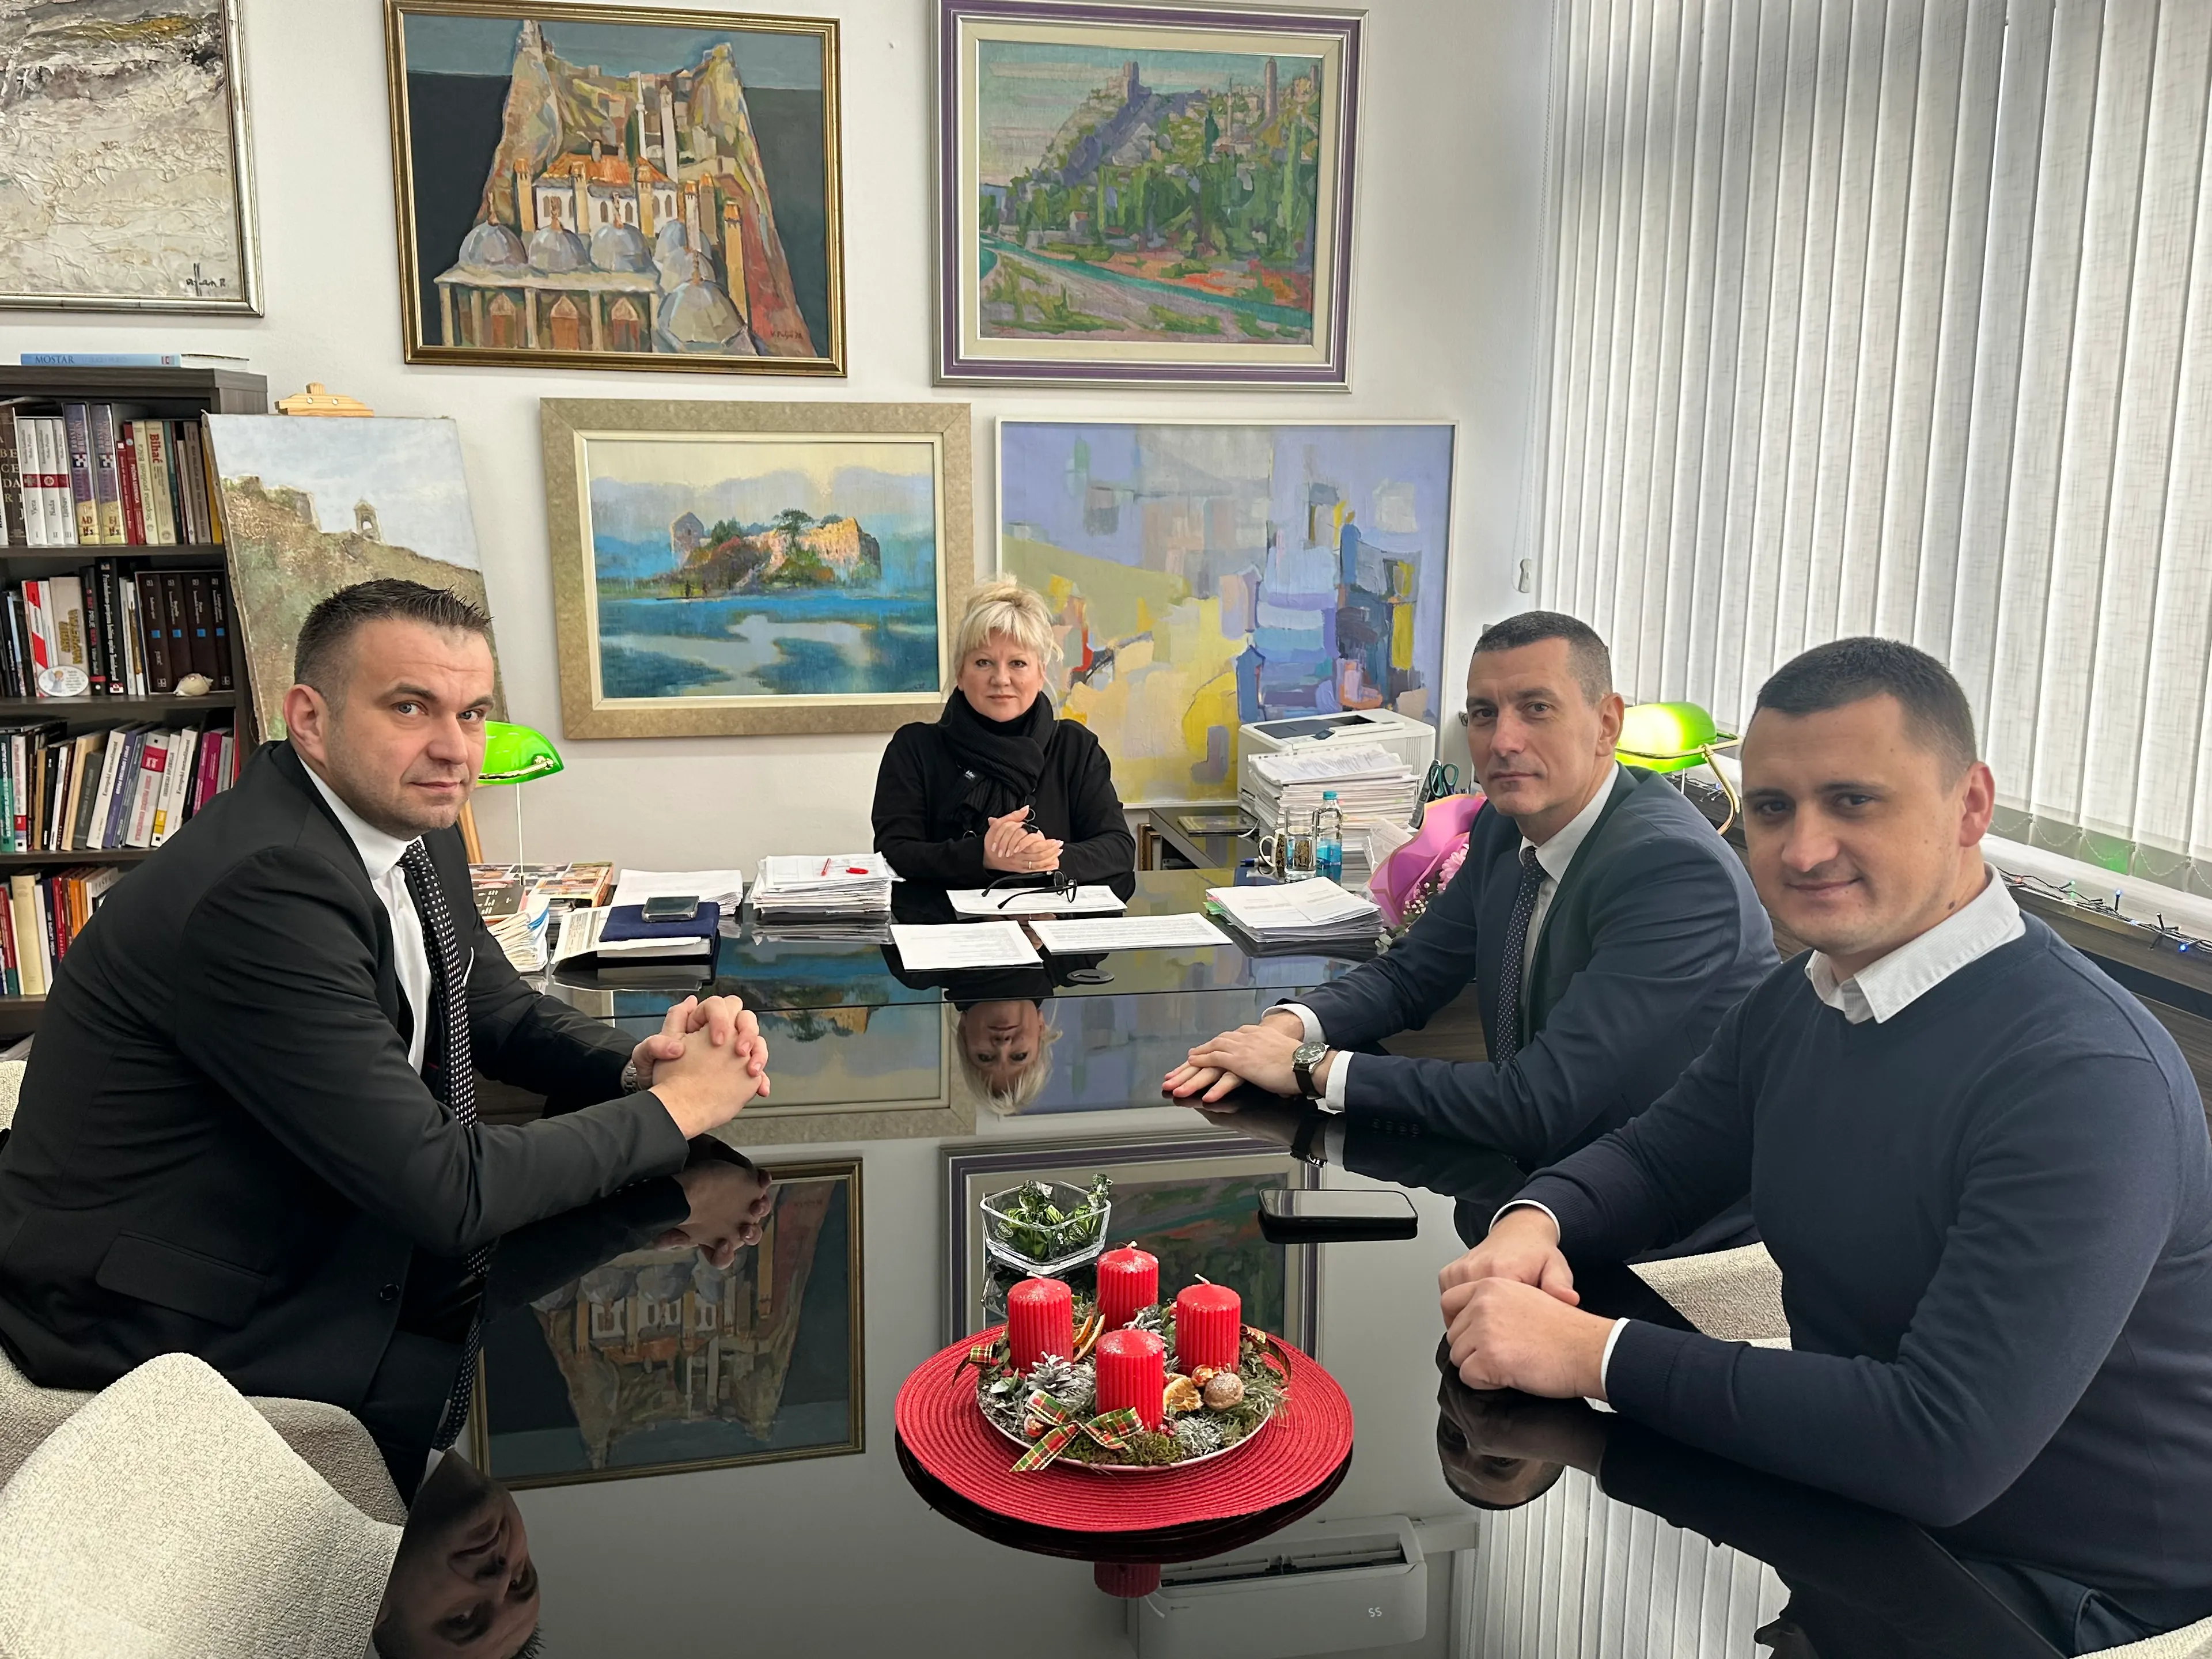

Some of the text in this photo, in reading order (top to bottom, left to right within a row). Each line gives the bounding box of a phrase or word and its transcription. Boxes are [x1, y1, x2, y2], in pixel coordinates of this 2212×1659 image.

[35, 355, 74, 364] MOSTAR
[150, 433, 163, 463] Bihać
[48, 499, 56, 516] Nada
[60, 497, 69, 517] Ljubav
[142, 493, 153, 521] Stopama
[103, 774, 111, 796] Europski
[176, 772, 184, 794] Europski
